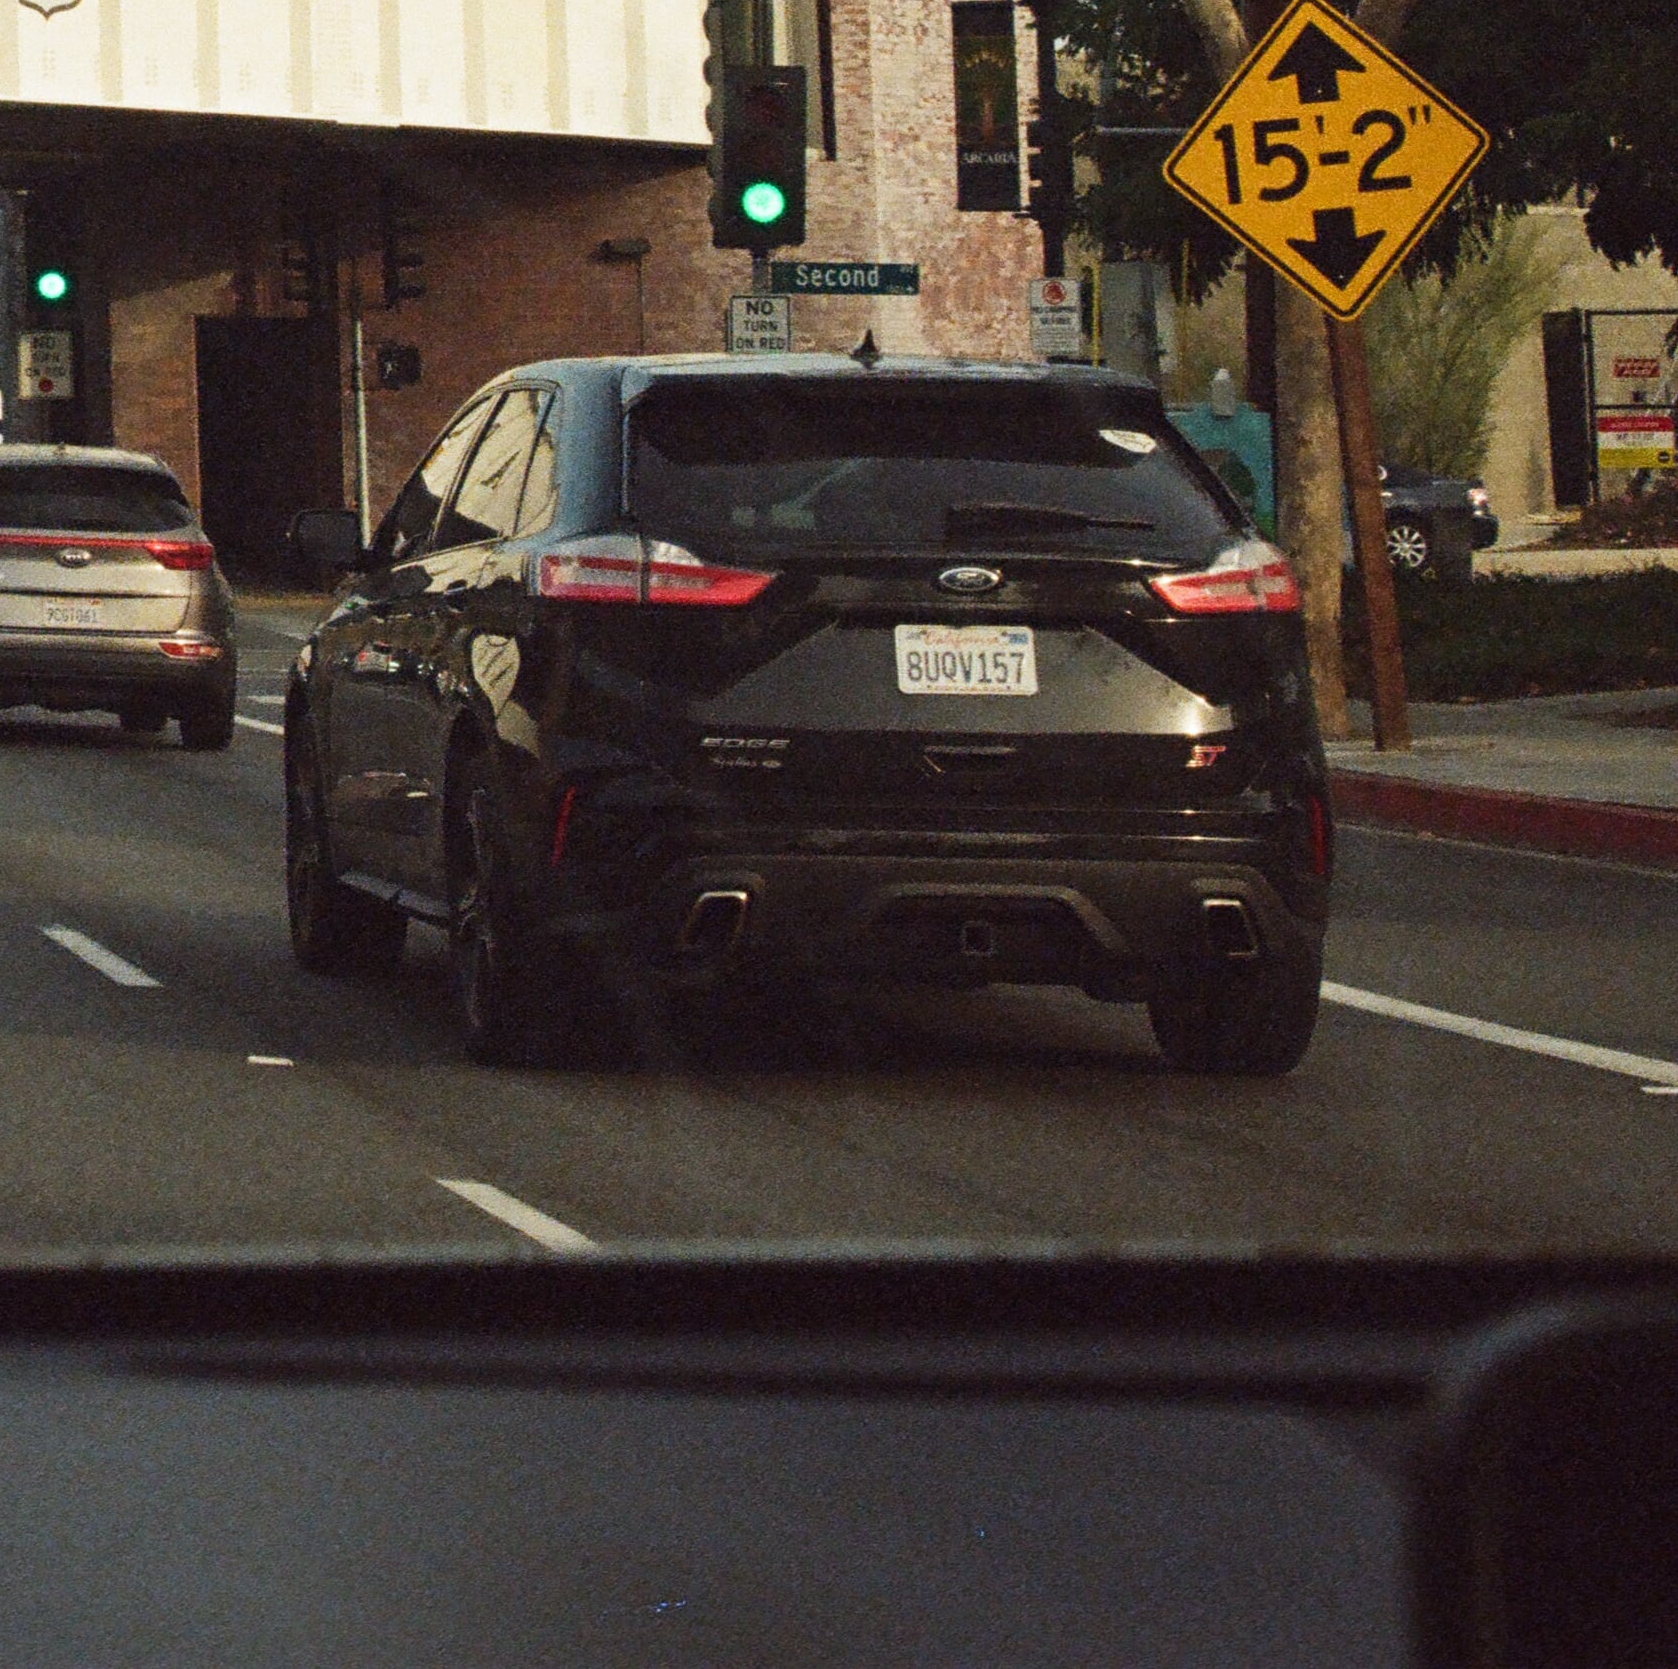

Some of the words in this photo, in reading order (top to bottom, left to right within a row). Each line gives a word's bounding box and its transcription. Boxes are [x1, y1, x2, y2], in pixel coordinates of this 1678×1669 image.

[795, 264, 880, 287] Second
[746, 300, 775, 315] NO
[744, 320, 779, 332] TURN
[736, 336, 755, 349] ON
[760, 336, 785, 349] RED
[906, 651, 1025, 684] 8UQV157
